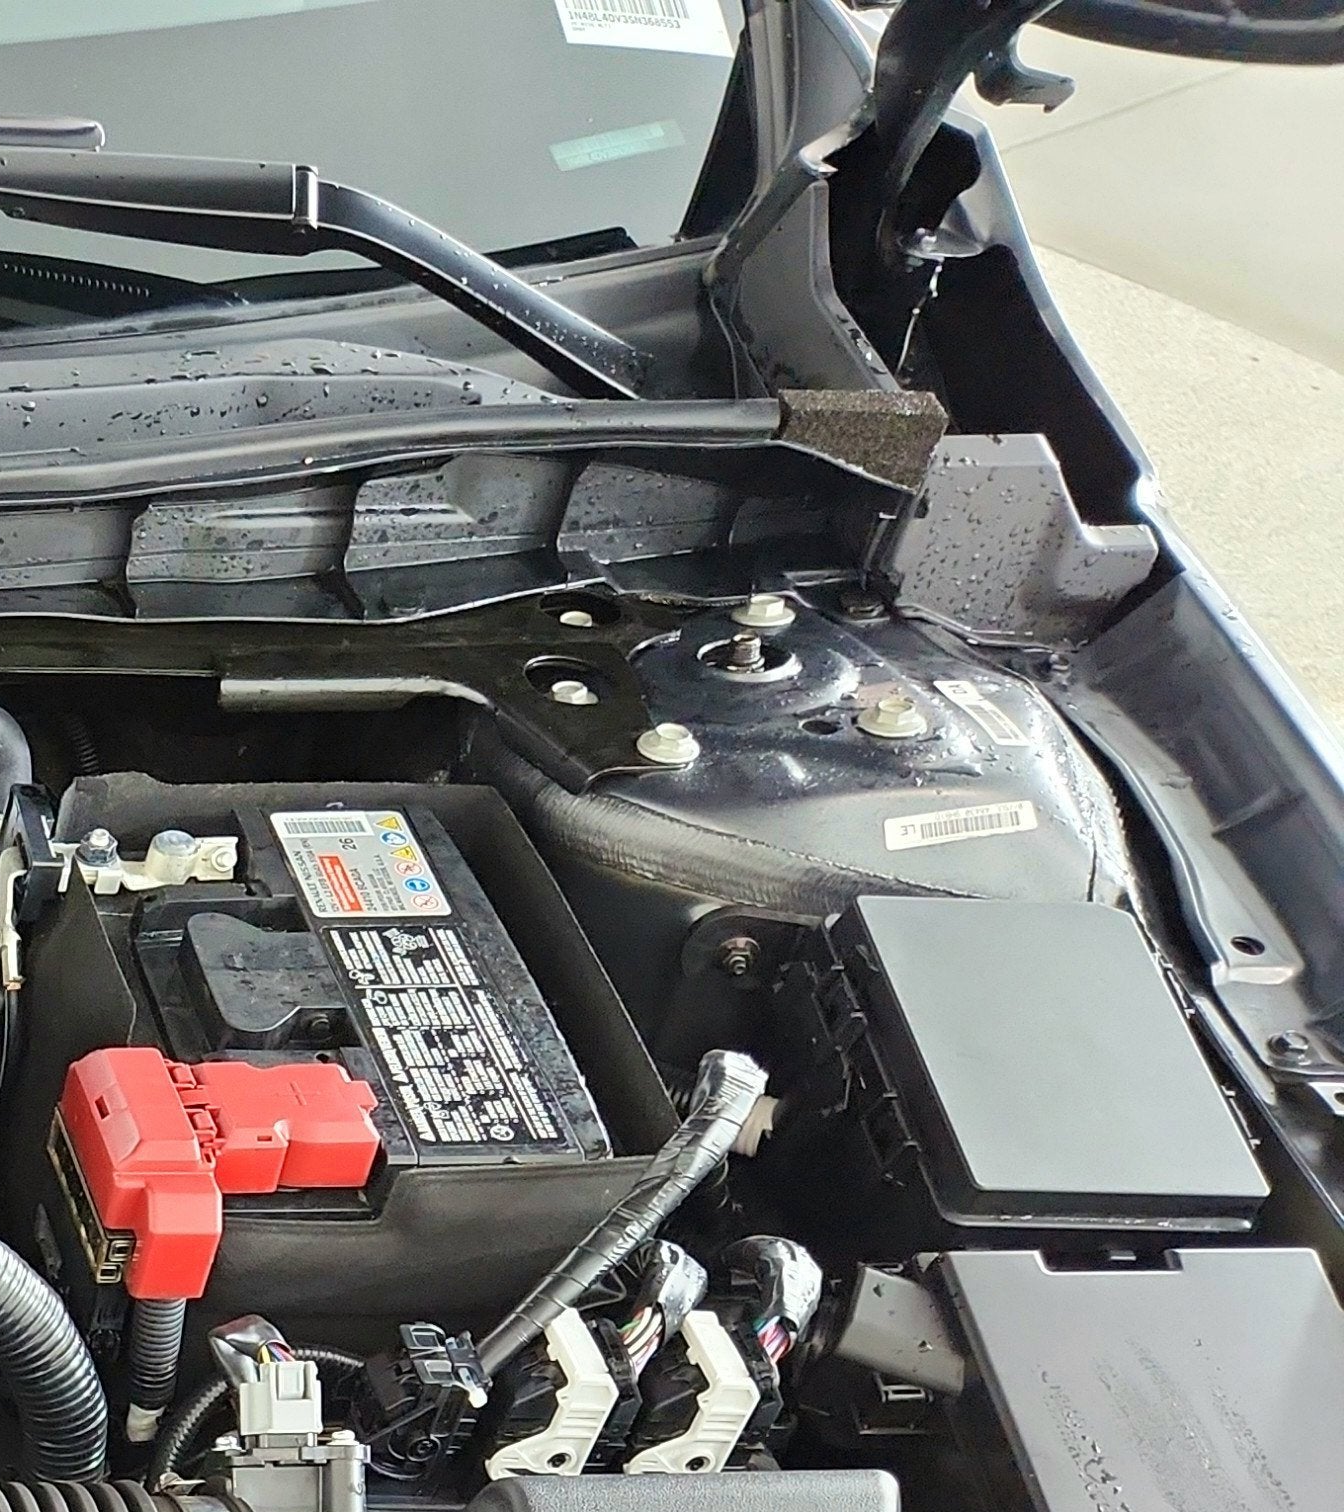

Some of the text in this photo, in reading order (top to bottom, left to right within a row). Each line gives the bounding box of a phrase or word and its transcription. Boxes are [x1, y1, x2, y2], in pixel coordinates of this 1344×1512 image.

[901, 824, 916, 836] LE
[337, 838, 357, 850] 26
[291, 850, 313, 880] NISSAN
